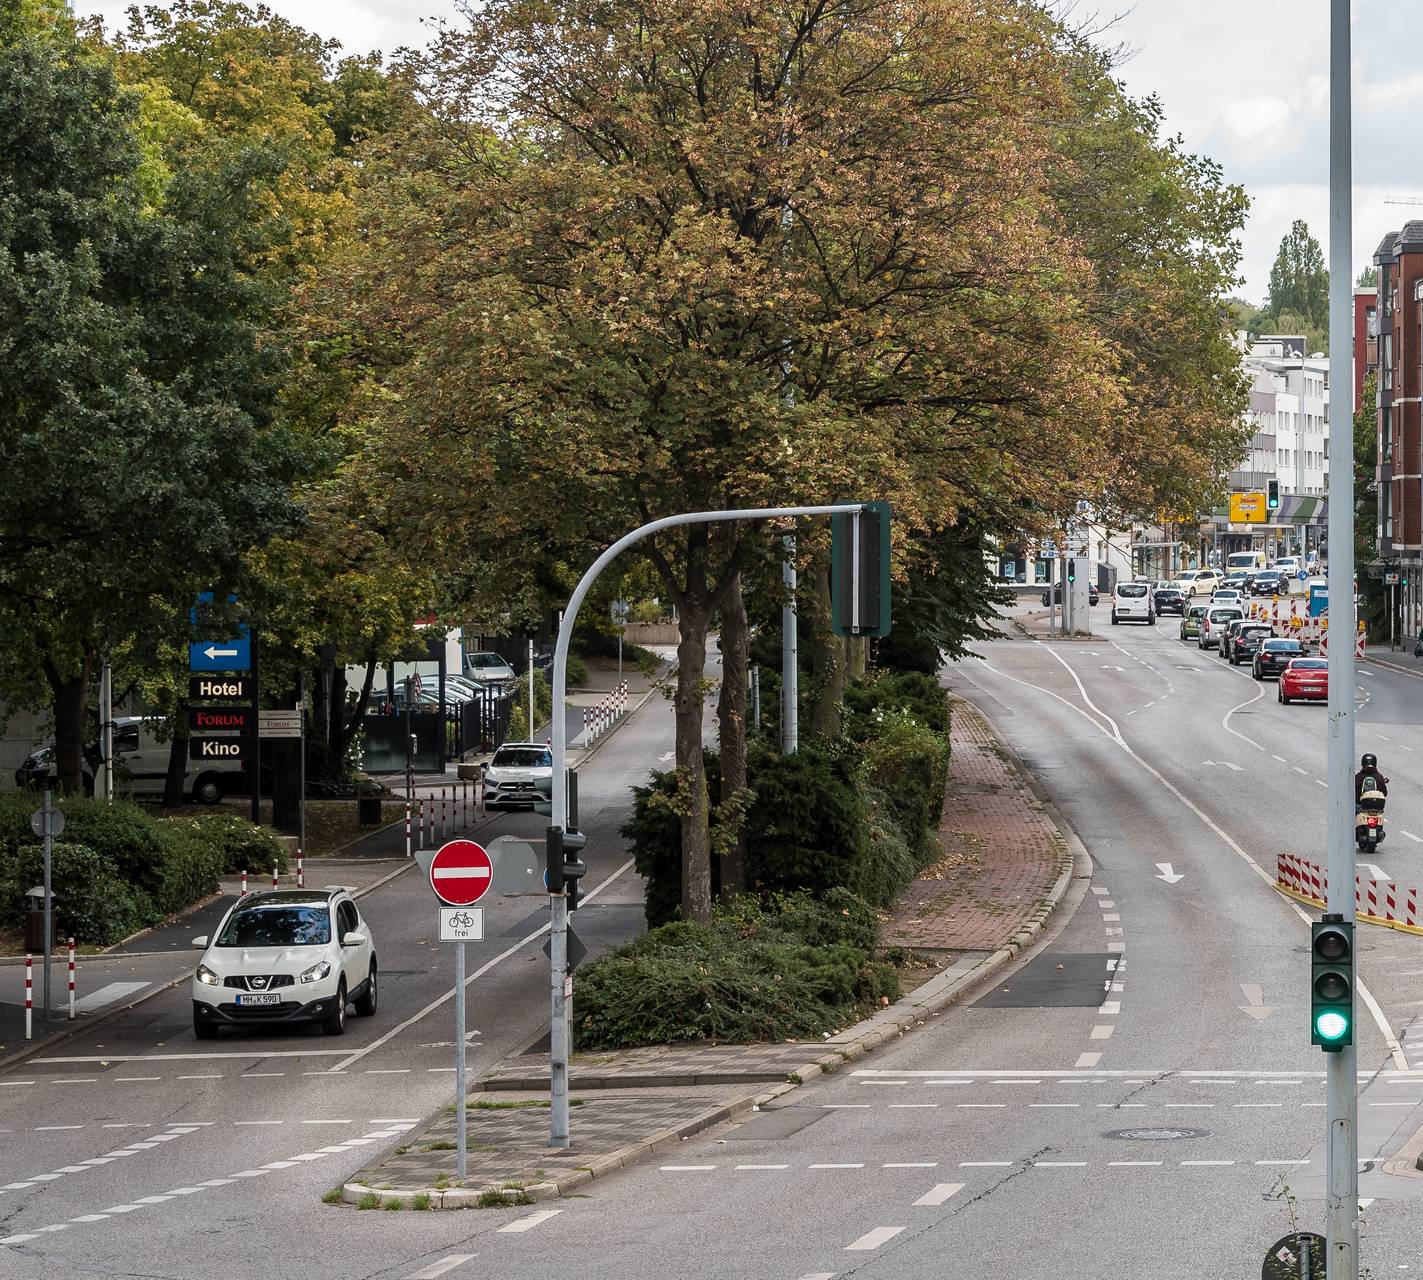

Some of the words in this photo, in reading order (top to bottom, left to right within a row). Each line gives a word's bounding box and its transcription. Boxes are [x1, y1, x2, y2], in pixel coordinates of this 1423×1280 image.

[200, 682, 242, 696] Hotel
[196, 712, 244, 726] FORUM
[202, 741, 240, 755] Kino
[454, 928, 469, 937] frei
